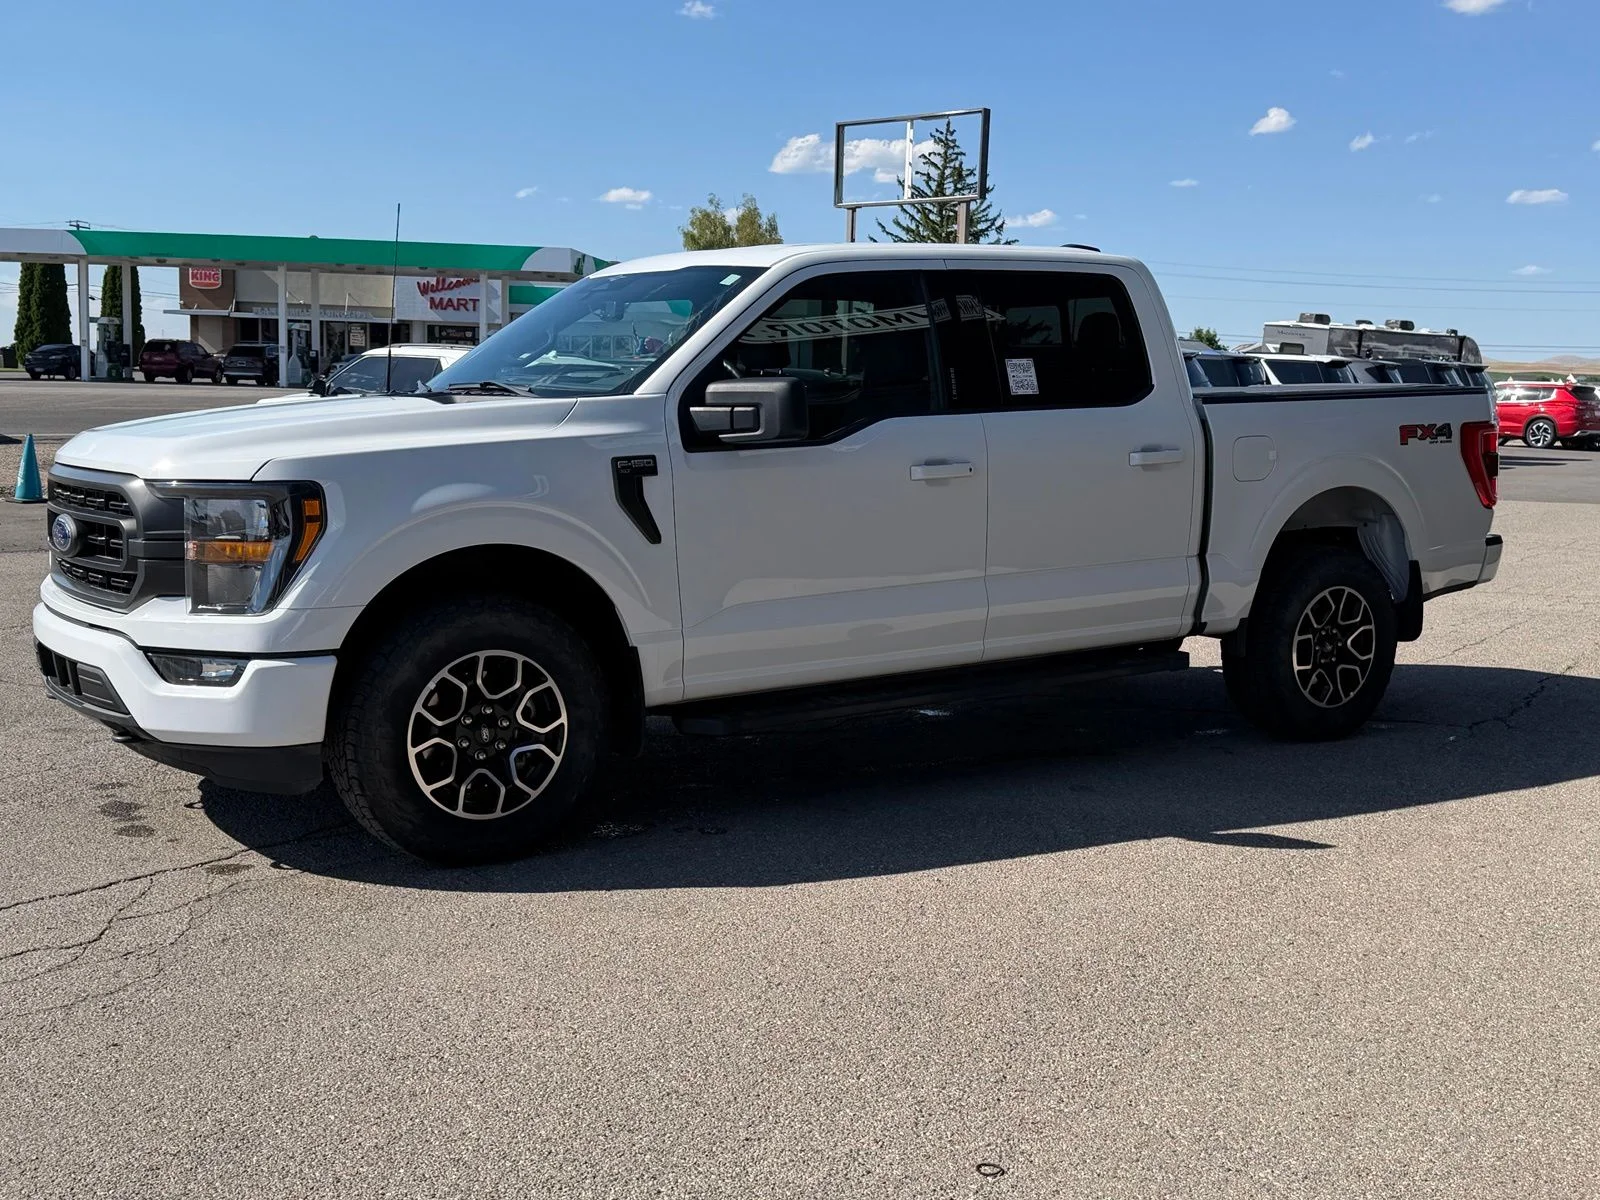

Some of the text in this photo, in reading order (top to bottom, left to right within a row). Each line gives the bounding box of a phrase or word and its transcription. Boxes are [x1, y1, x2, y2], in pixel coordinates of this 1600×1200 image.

[191, 270, 220, 281] KING
[430, 297, 480, 312] MART
[1399, 423, 1452, 445] FX4
[617, 459, 654, 468] F-150
